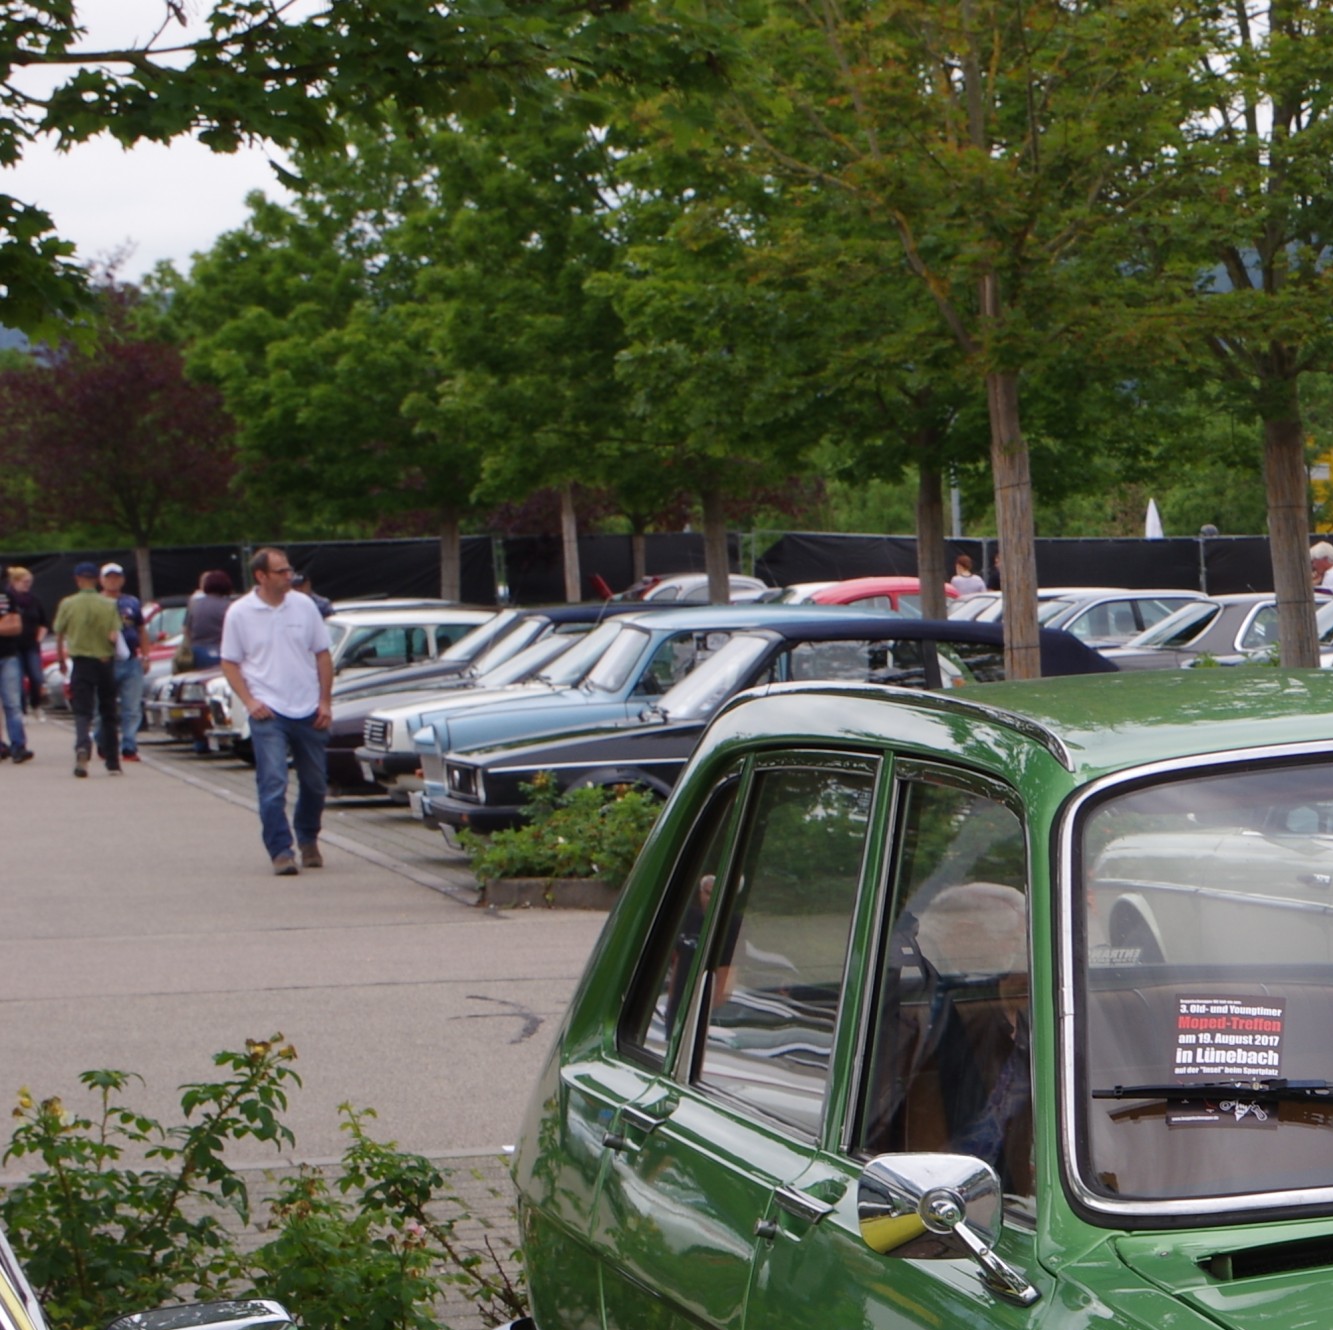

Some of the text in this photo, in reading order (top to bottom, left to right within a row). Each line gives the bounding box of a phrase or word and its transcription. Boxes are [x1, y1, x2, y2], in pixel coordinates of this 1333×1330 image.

[1180, 1004, 1282, 1017] 3. Old- und Youngtimer
[1178, 1016, 1281, 1032] Moped-Treffen
[1178, 1033, 1280, 1047] am 19. August 2017
[1176, 1047, 1279, 1066] in Lünebach
